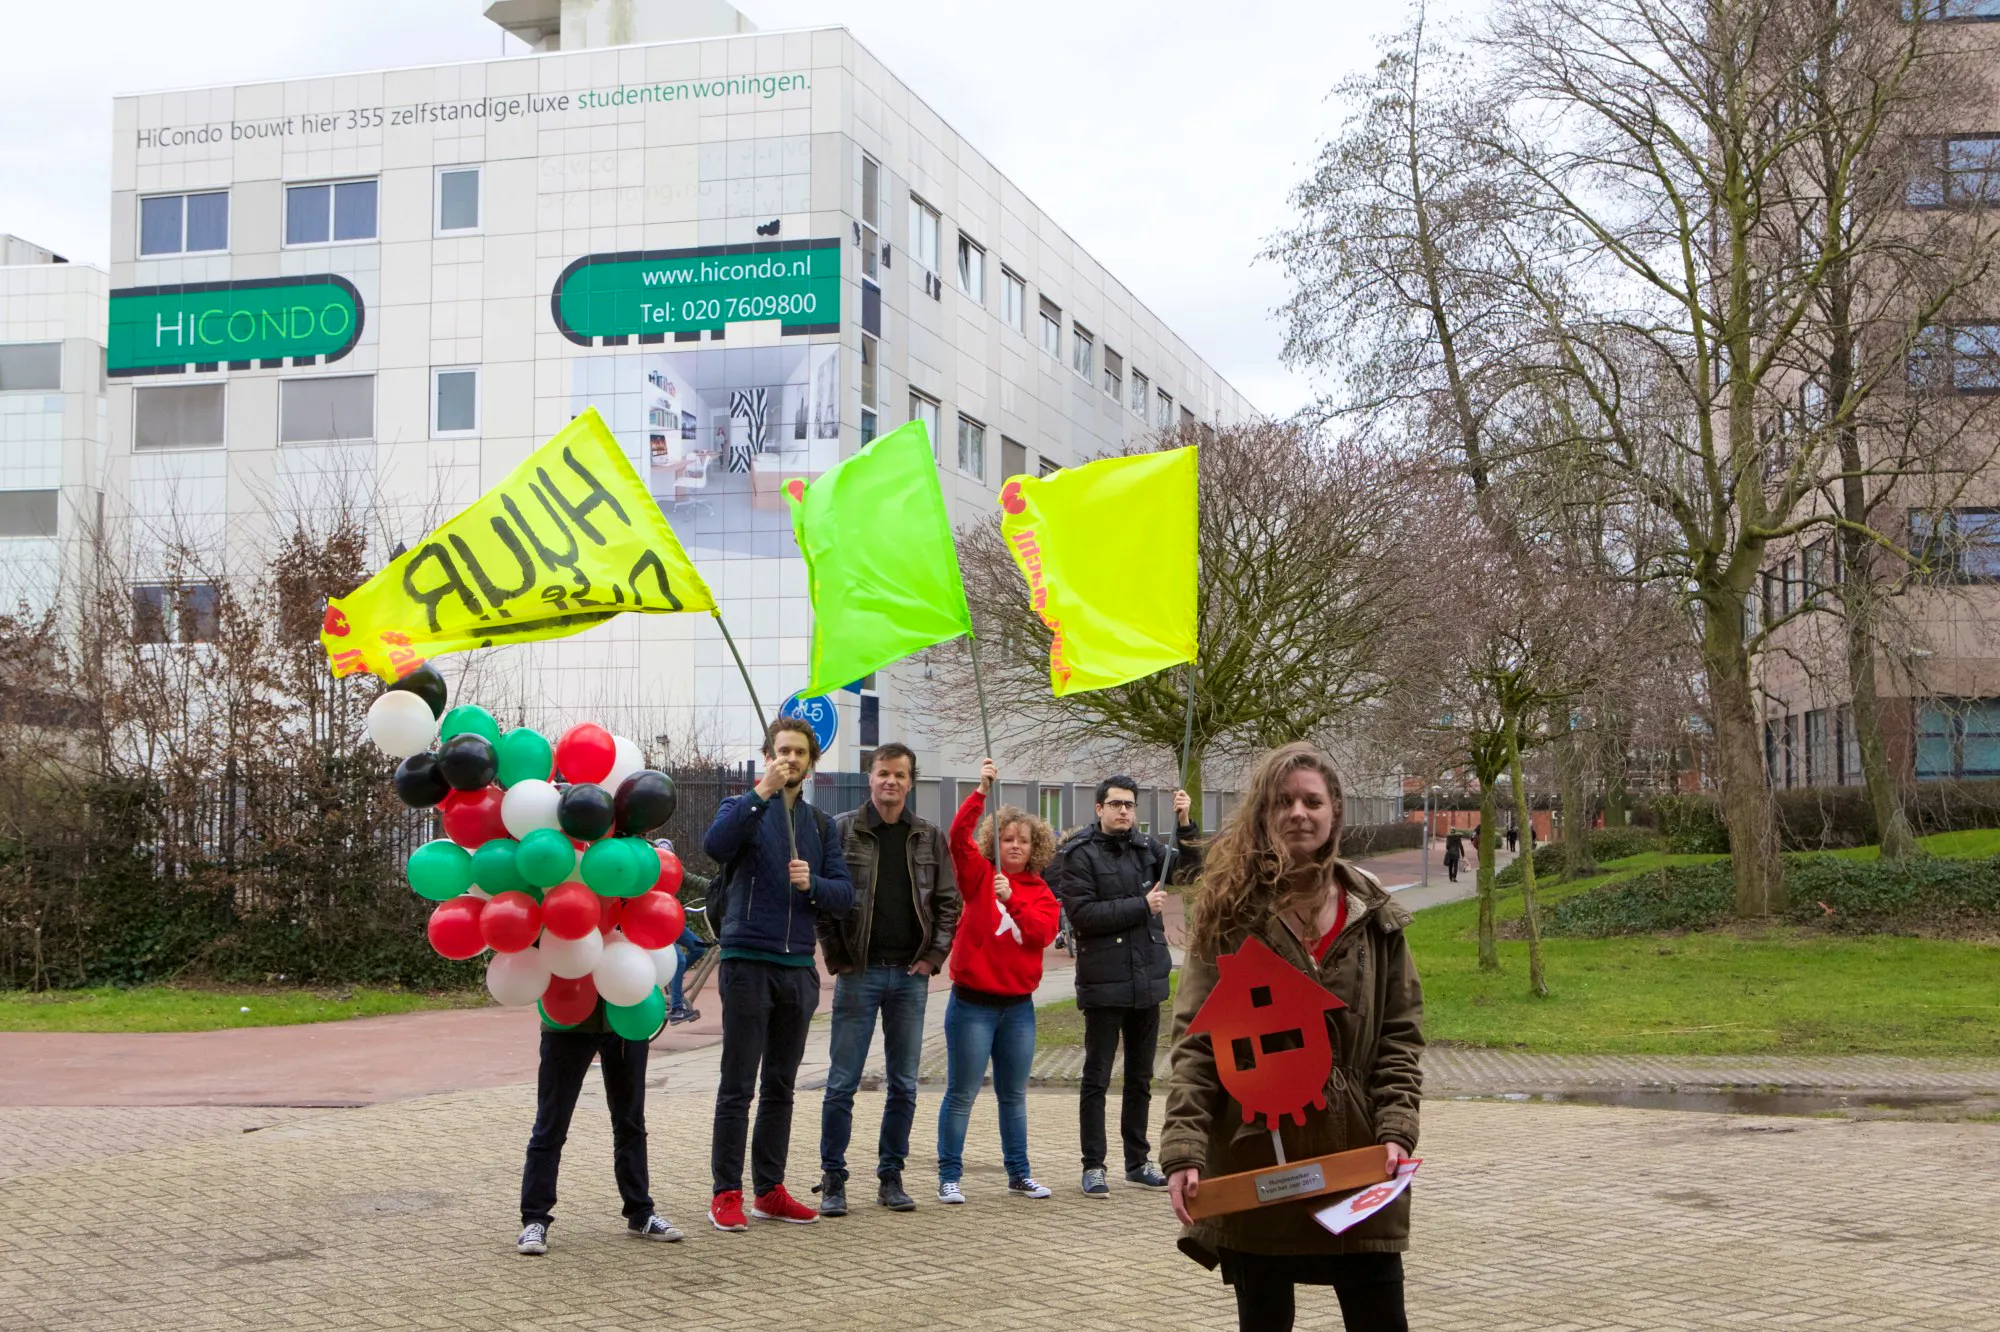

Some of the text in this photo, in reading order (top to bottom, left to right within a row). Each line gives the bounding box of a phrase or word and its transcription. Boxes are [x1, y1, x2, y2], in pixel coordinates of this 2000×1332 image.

[137, 124, 223, 149] HiCondo
[231, 121, 294, 140] bouwt
[302, 114, 340, 134] hier
[347, 108, 384, 129] 355
[642, 255, 811, 286] www.hicondo.nl
[640, 294, 817, 324] Tel: 020 7609800
